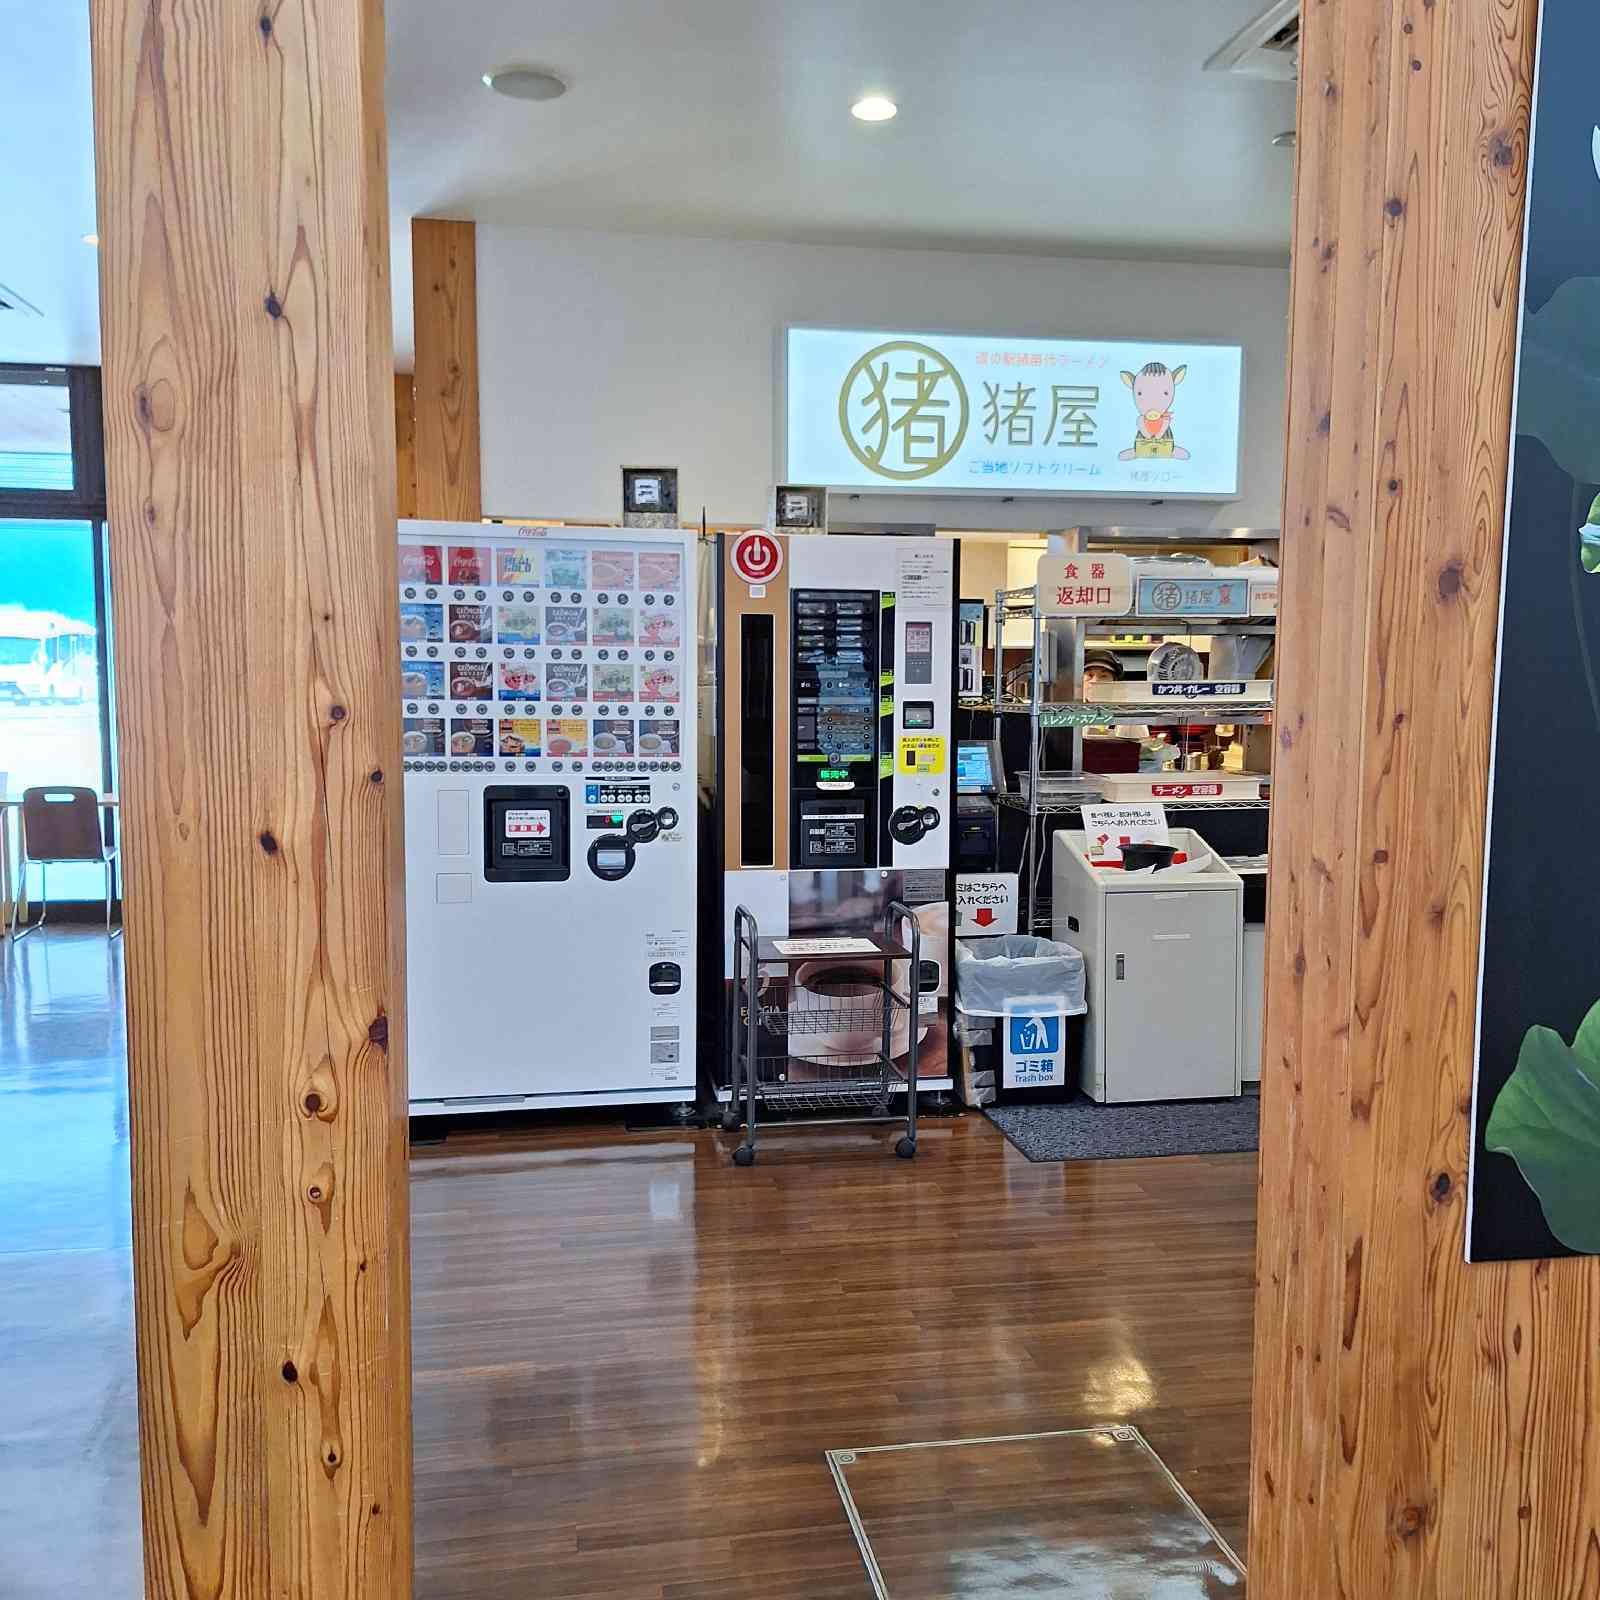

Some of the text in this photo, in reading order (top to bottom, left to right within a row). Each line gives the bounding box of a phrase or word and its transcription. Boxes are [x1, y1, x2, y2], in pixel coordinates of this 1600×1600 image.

[861, 357, 950, 465] 猪
[982, 380, 1101, 449] 猪屋
[968, 460, 1102, 476] ご当地ソフトクリーム
[1056, 585, 1112, 605] 返却口
[1050, 713, 1114, 726] レンゲ・スプーン
[1154, 785, 1188, 796] ラーメン
[1015, 1058, 1054, 1073] ゴミ箱
[1015, 1073, 1055, 1083] Trash box
